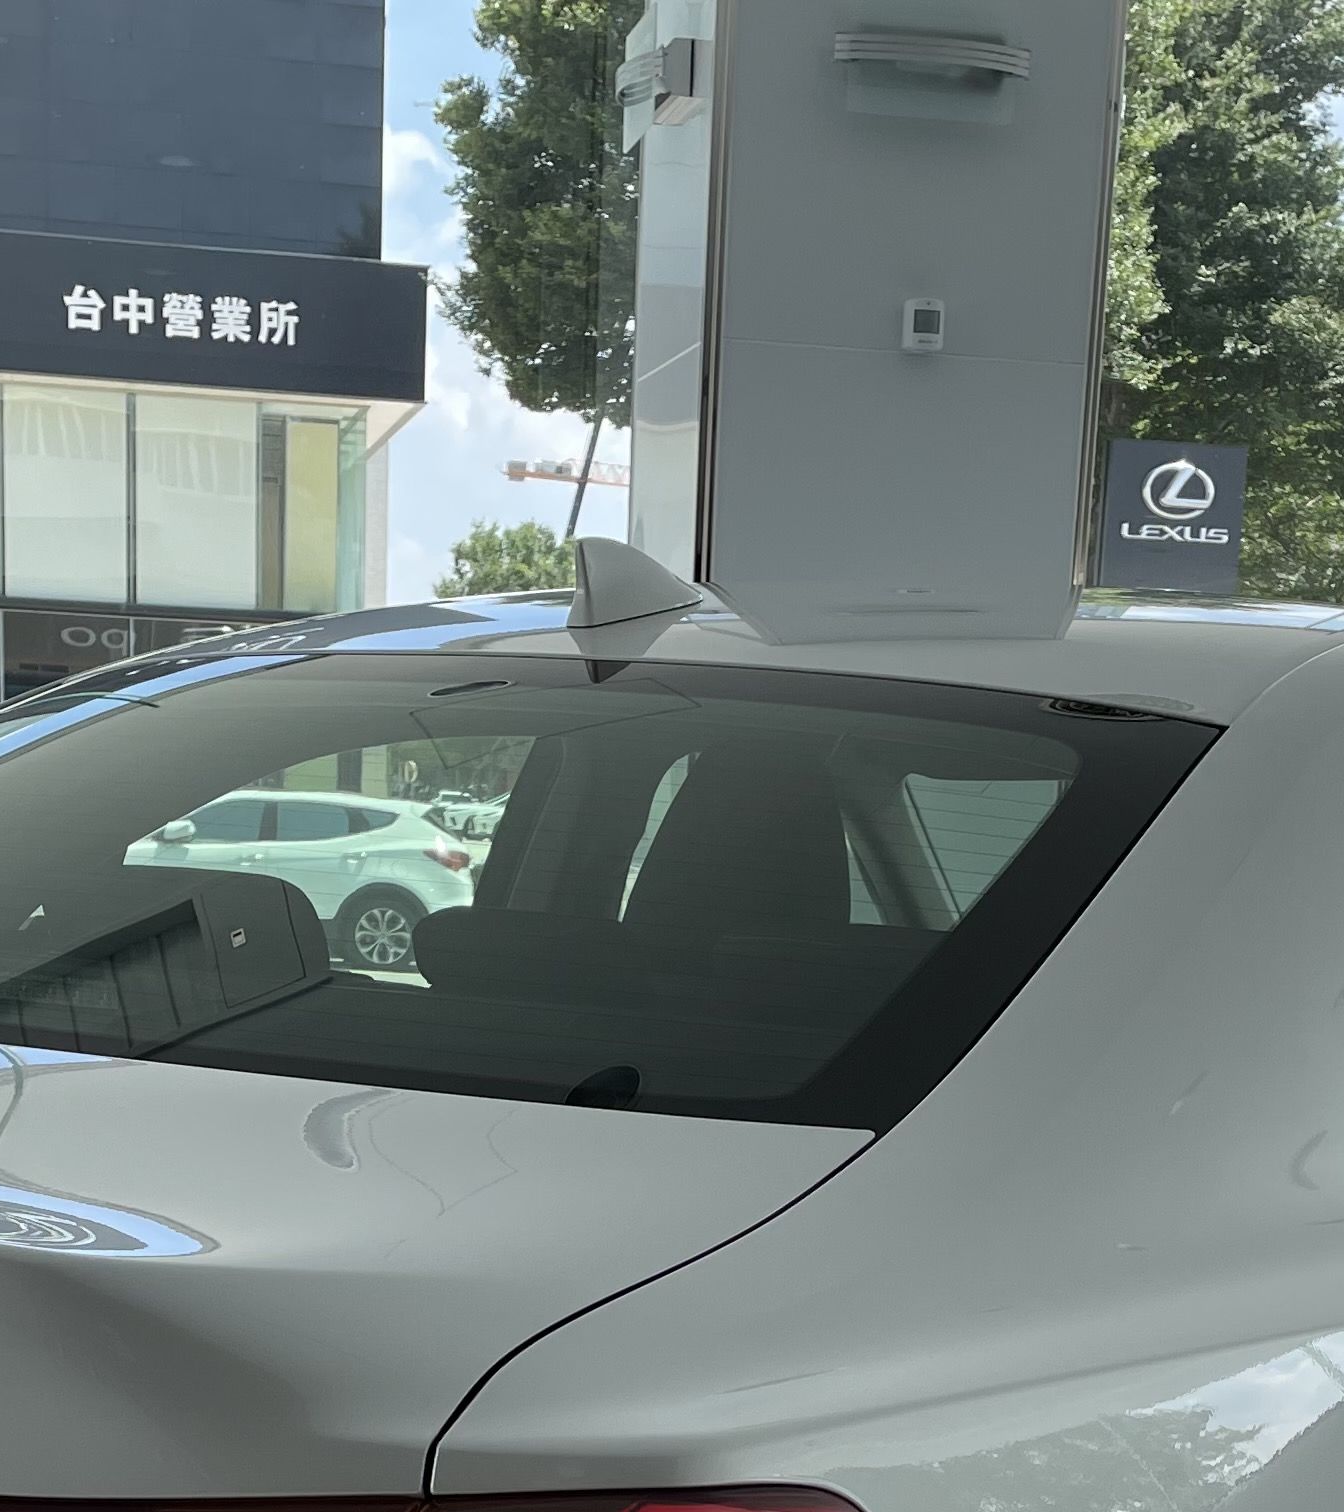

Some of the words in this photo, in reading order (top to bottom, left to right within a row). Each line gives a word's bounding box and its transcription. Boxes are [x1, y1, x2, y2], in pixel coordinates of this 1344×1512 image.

[62, 284, 301, 346] 台中營業所
[1120, 522, 1229, 544] LEXUS
